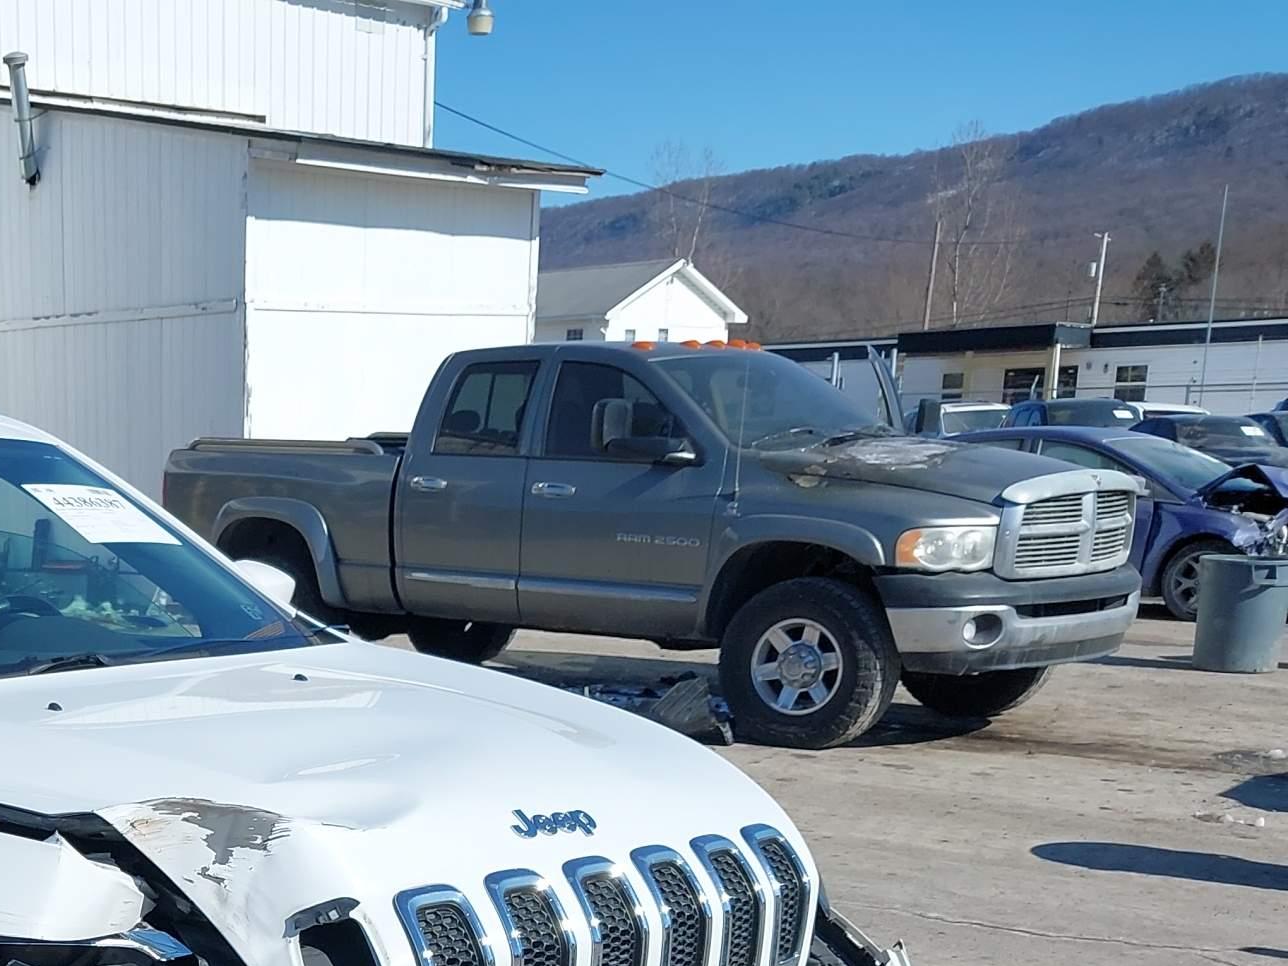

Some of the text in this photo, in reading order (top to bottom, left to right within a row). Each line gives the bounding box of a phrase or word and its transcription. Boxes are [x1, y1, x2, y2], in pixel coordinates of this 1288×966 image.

[52, 496, 126, 510] 44386387
[616, 533, 700, 546] RAM 2500
[511, 809, 597, 838] Jeep
